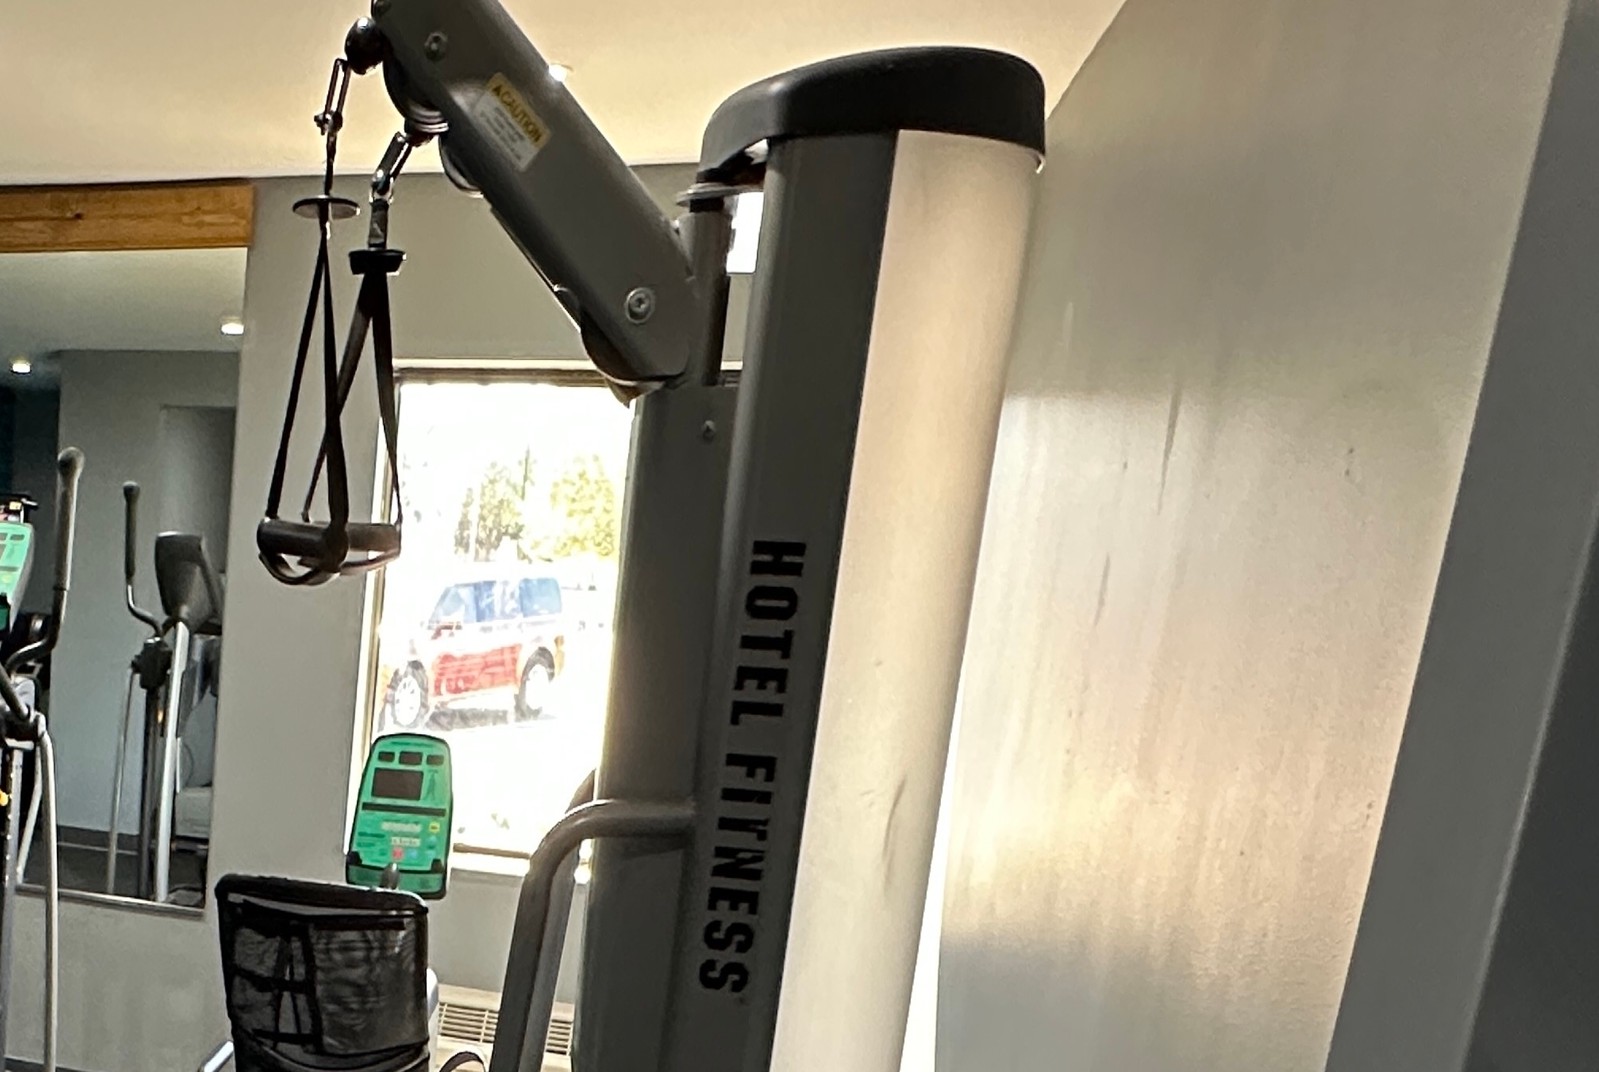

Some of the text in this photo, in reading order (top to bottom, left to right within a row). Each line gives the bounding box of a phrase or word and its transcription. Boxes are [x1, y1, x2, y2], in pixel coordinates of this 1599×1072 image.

[500, 91, 543, 143] CAUTION
[697, 539, 807, 995] HOTEL FITNESS
